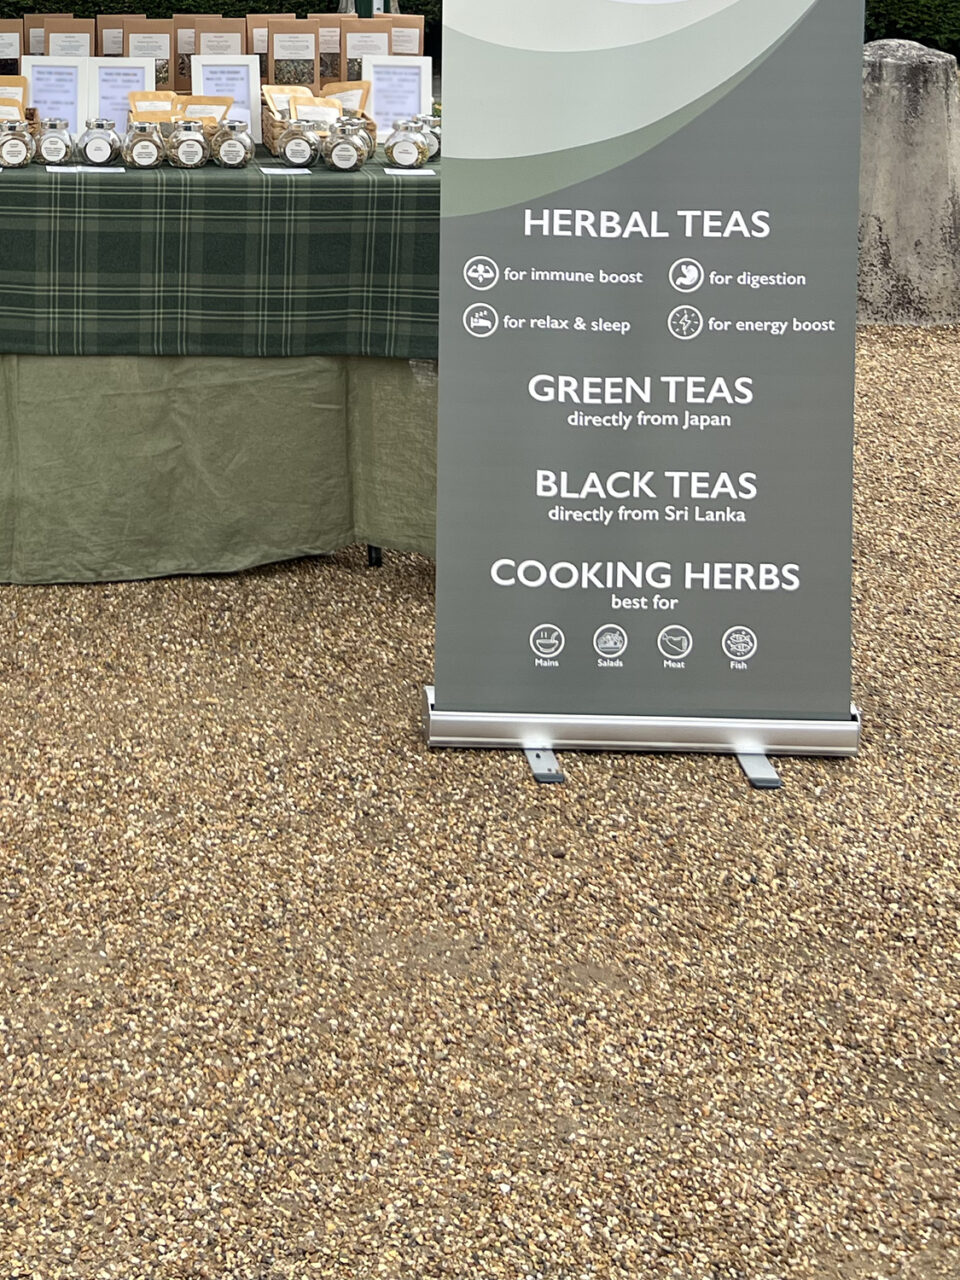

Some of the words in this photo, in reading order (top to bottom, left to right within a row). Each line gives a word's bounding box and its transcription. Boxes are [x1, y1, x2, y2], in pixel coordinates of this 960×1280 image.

[524, 208, 670, 239] HERBAL
[676, 210, 771, 238] TEAS
[503, 266, 528, 281] for
[531, 267, 595, 283] immune
[599, 269, 644, 284] boost
[708, 270, 734, 285] for
[736, 271, 806, 289] digestion
[503, 314, 527, 329] for
[530, 314, 569, 330] relax
[573, 316, 587, 331] &
[590, 317, 631, 335] sleep
[707, 316, 732, 331] for
[735, 320, 789, 335] energy
[792, 317, 836, 332] boost
[528, 374, 651, 405] GREEN
[660, 376, 754, 405] TEAS
[567, 410, 633, 431] directly
[636, 410, 679, 426] from
[682, 410, 732, 431] Japan
[536, 469, 657, 499] BLACK
[664, 471, 758, 500] TEAS
[547, 505, 614, 526] directly
[617, 505, 660, 521] from
[664, 505, 689, 521] Sri
[694, 505, 747, 522] Lanka
[490, 558, 672, 589] COOKING
[684, 562, 800, 591] HERBS
[611, 593, 649, 610] best
[652, 594, 679, 610] for
[534, 658, 560, 667] Mains
[597, 658, 624, 668] Salads
[663, 660, 685, 669] Meat
[730, 661, 748, 670] Fish
